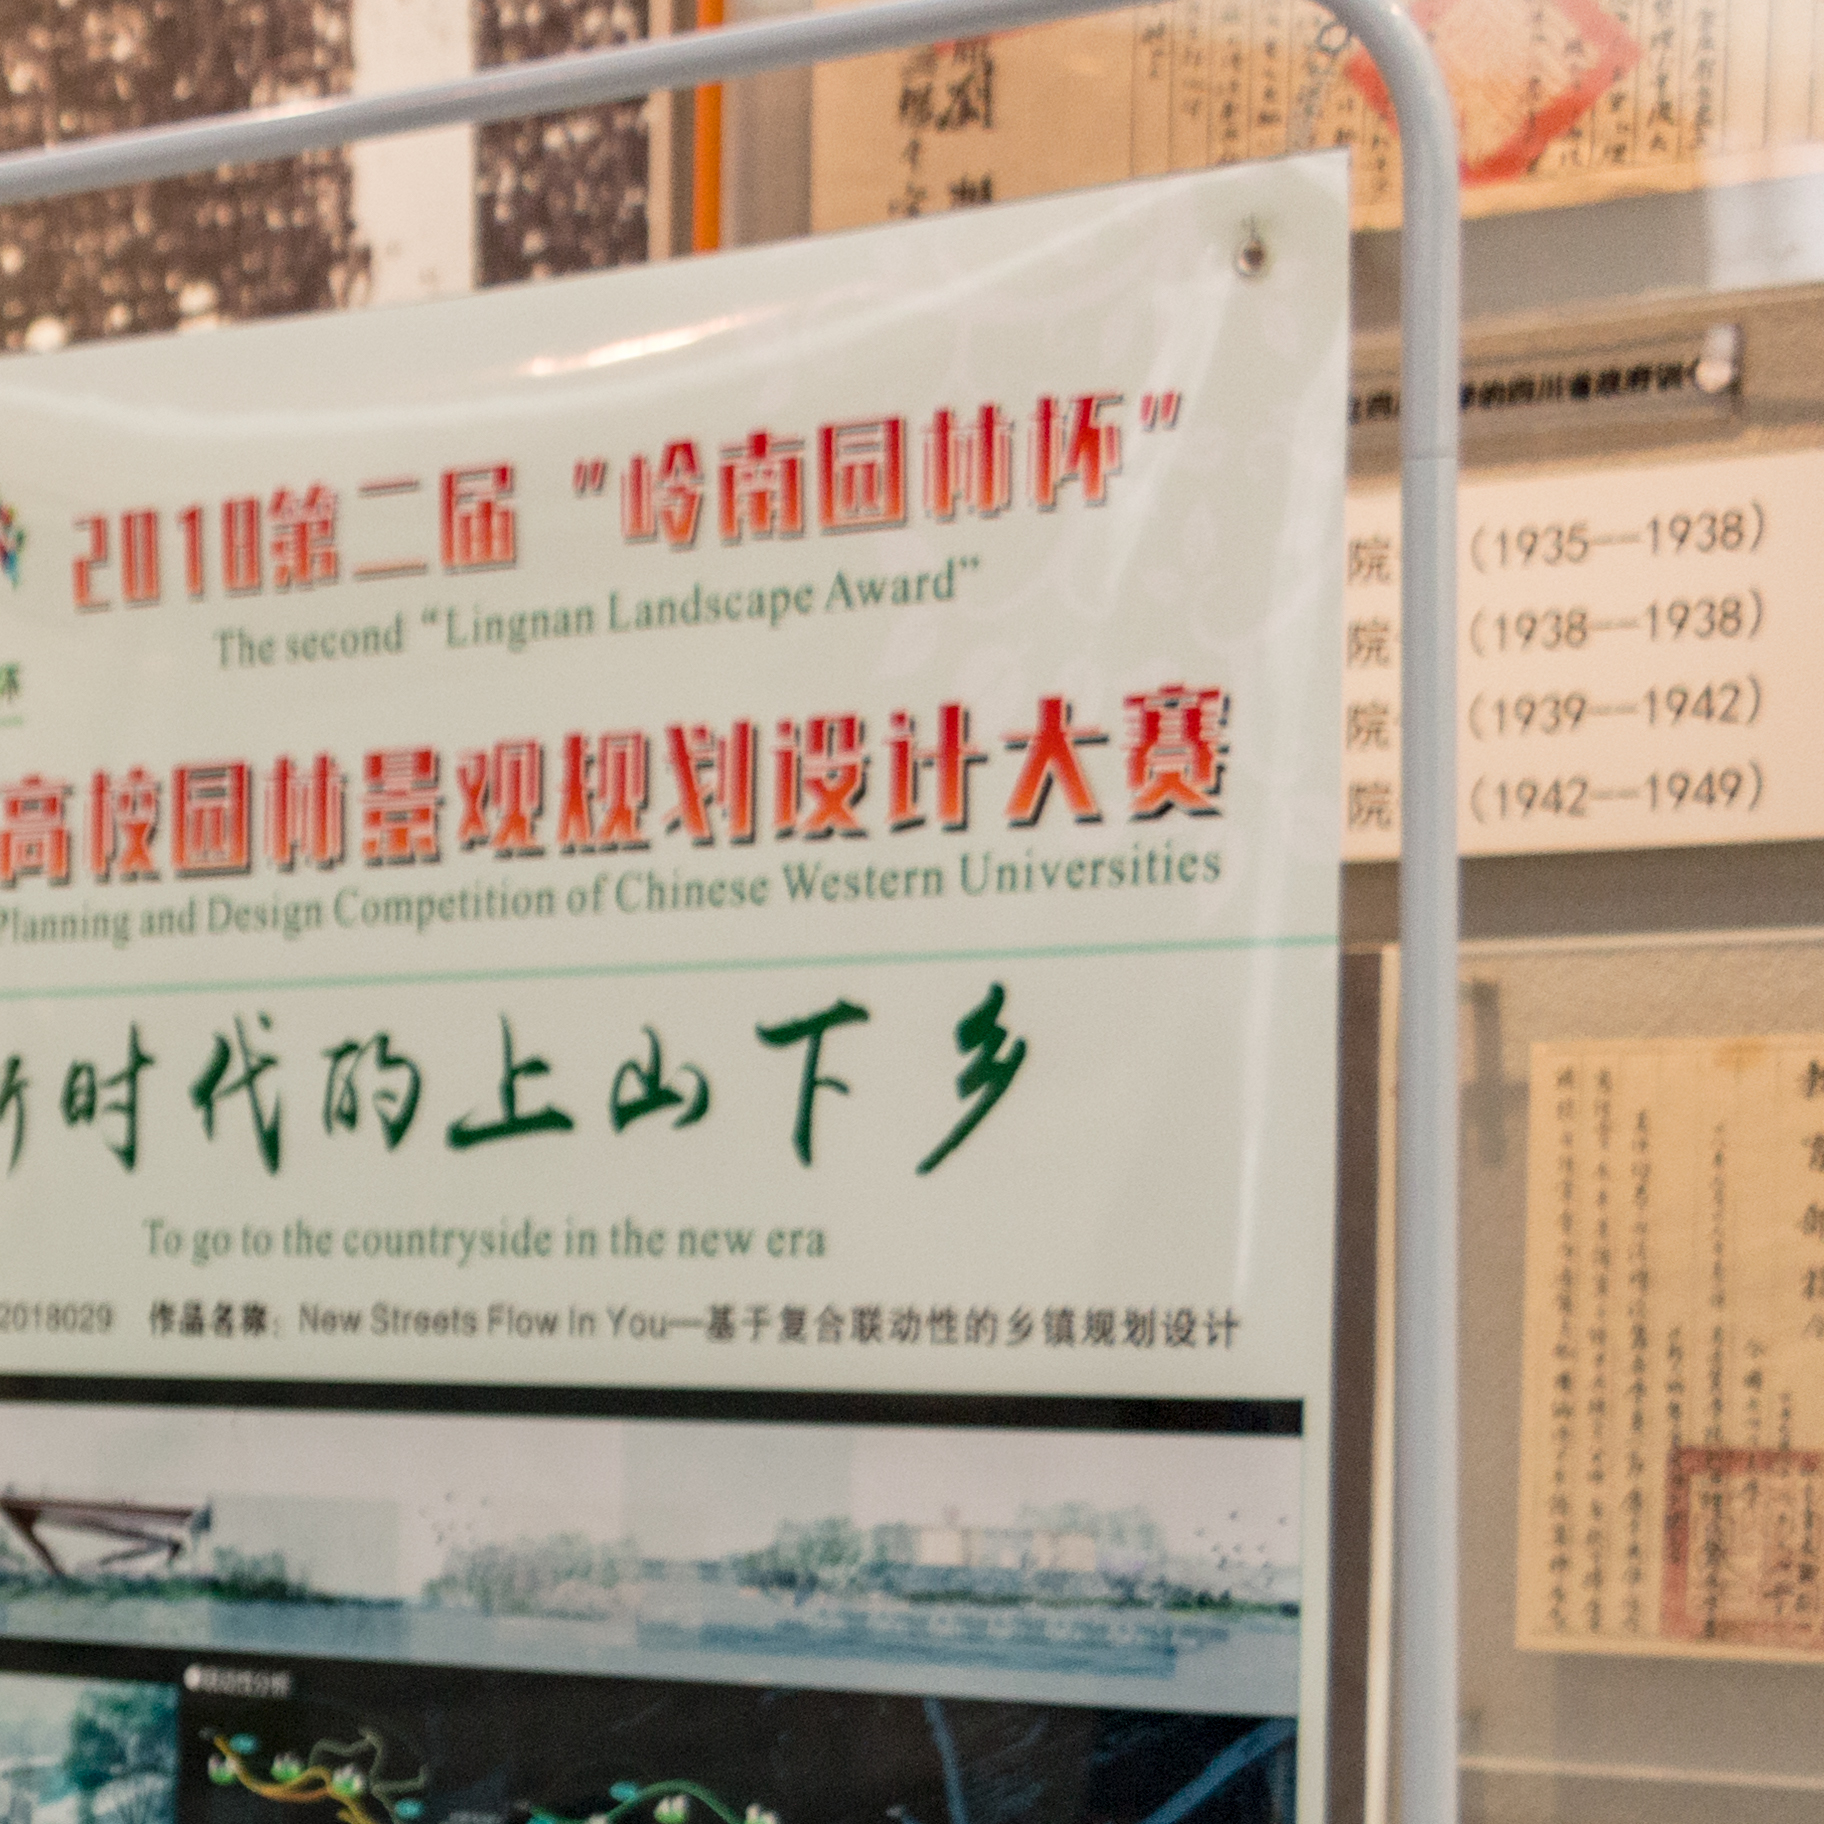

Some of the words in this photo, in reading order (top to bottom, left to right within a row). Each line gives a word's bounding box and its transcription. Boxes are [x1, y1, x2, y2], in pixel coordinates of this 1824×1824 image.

[212, 623, 277, 671] The
[285, 612, 407, 662] second
[606, 574, 815, 636] Landscape
[138, 895, 198, 937] and
[206, 884, 324, 939] Design
[331, 876, 555, 931] Competition
[565, 872, 606, 916] of
[613, 864, 770, 913] Chinese
[781, 857, 946, 904] Western
[958, 838, 1226, 898] Universities
[142, 1215, 185, 1261] To
[191, 1226, 233, 1268] go
[241, 1219, 274, 1260] to
[281, 1215, 334, 1260] the
[342, 1214, 553, 1269] countryside
[562, 1215, 598, 1260] in
[607, 1214, 669, 1260] the
[675, 1226, 755, 1260] new
[765, 1228, 827, 1260] era
[297, 1301, 364, 1336] New
[369, 1300, 479, 1339] Streets
[486, 1302, 558, 1339] Flow
[567, 1304, 598, 1339] In
